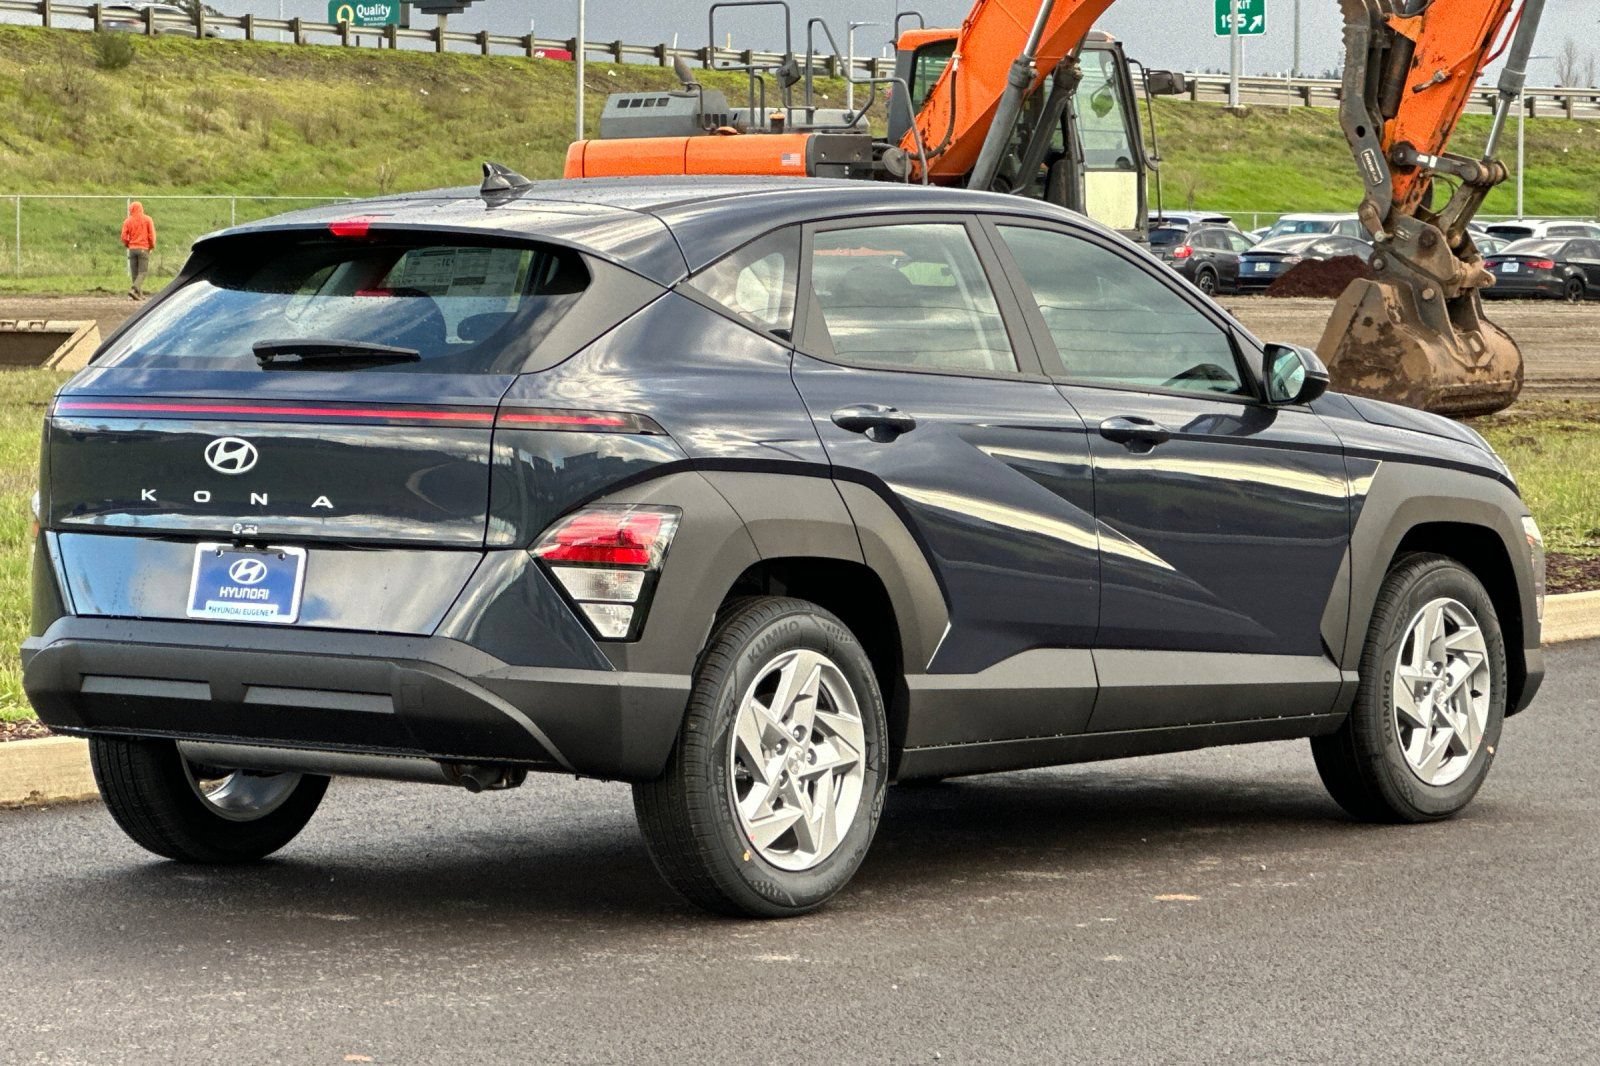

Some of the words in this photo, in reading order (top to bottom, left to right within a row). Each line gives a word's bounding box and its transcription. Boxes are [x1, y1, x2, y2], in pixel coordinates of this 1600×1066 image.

[356, 4, 391, 18] Quality
[1231, 0, 1252, 9] XIT
[141, 489, 334, 509] KONA
[219, 586, 269, 600] HYUNDAI
[211, 607, 241, 615] HYUNDAI
[243, 608, 269, 616] EUGENE
[747, 620, 800, 664] KUMHO
[1383, 669, 1394, 746] KUMHO
